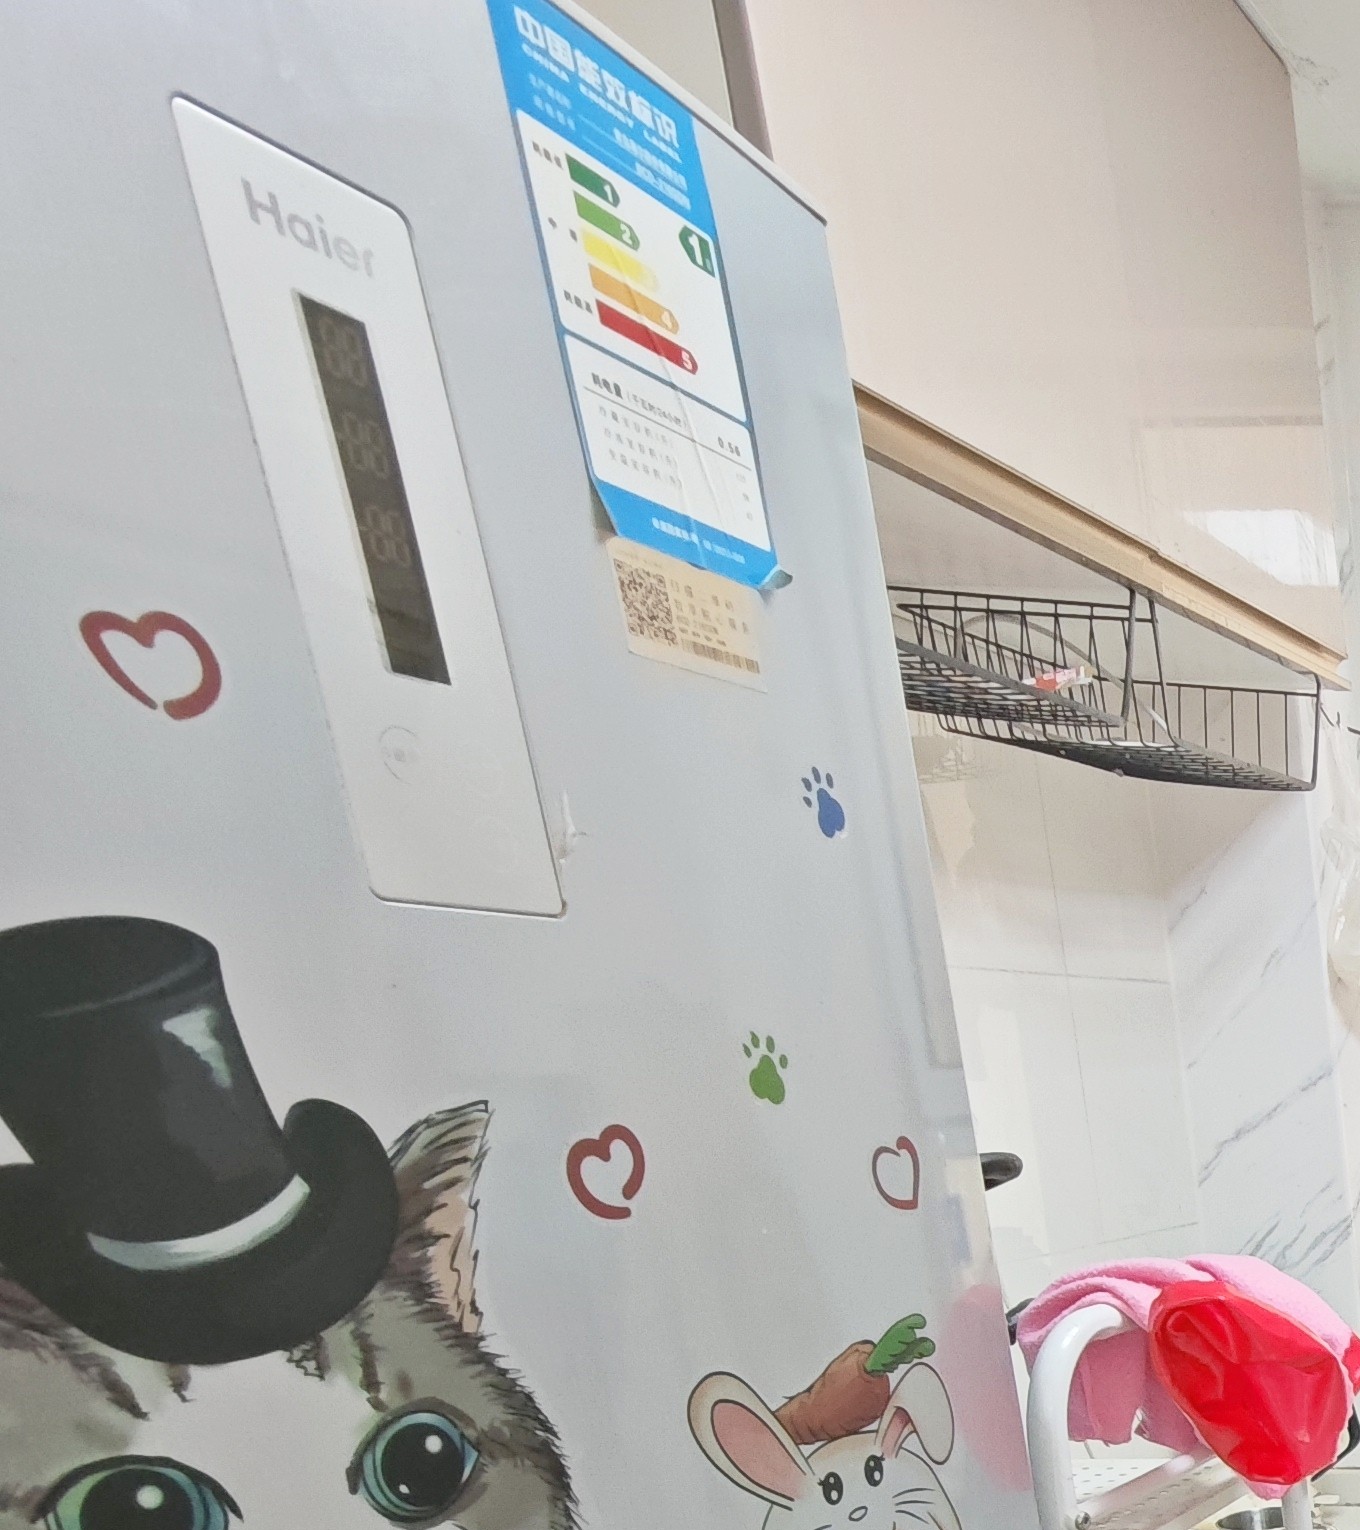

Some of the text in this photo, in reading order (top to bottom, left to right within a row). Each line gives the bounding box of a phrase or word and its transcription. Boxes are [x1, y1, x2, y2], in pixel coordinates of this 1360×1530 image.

[240, 175, 375, 279] Haier
[620, 222, 633, 246] 2
[688, 233, 704, 267] 1
[681, 350, 693, 371] 5
